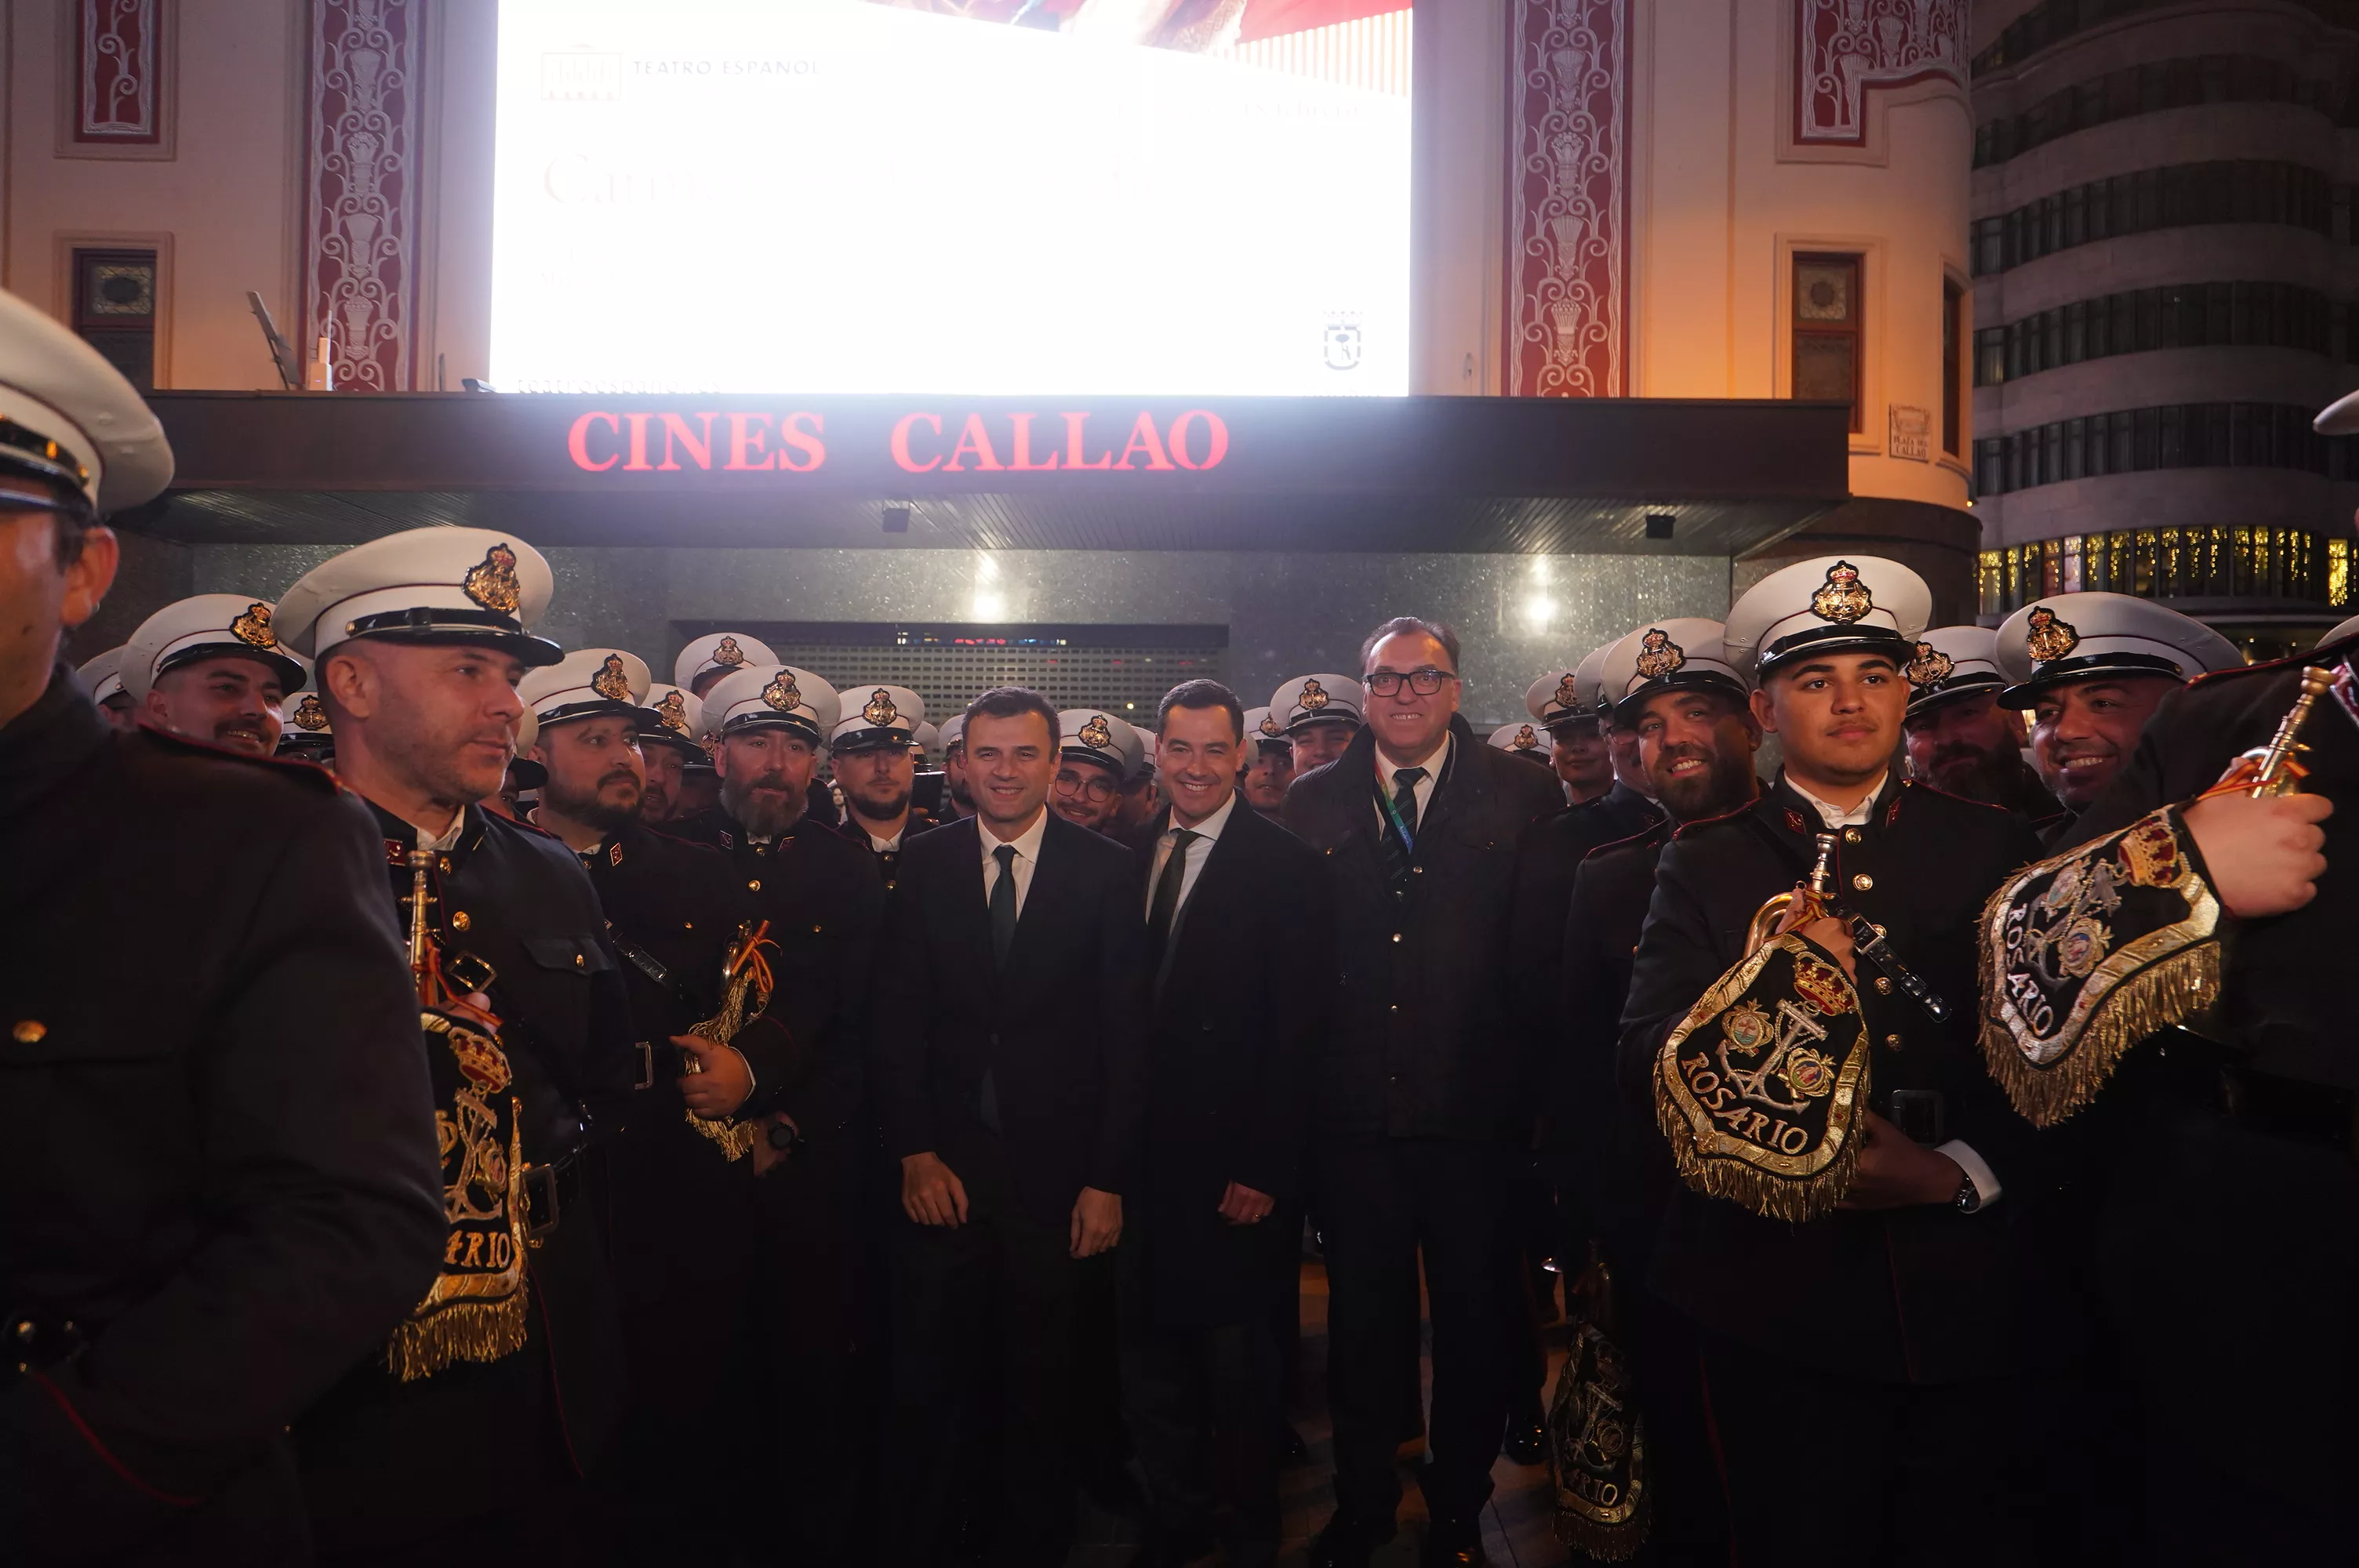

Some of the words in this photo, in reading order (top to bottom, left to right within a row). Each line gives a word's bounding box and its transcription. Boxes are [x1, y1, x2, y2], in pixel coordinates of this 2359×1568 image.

[632, 60, 712, 75] TEATRO
[568, 412, 826, 472] CINES
[891, 410, 1229, 473] CALLAO
[1896, 446, 1926, 459] CALLAO
[2005, 902, 2054, 1037] ROSARIO
[1681, 1051, 1808, 1155] ROSARIO
[445, 1229, 511, 1269] ARIO
